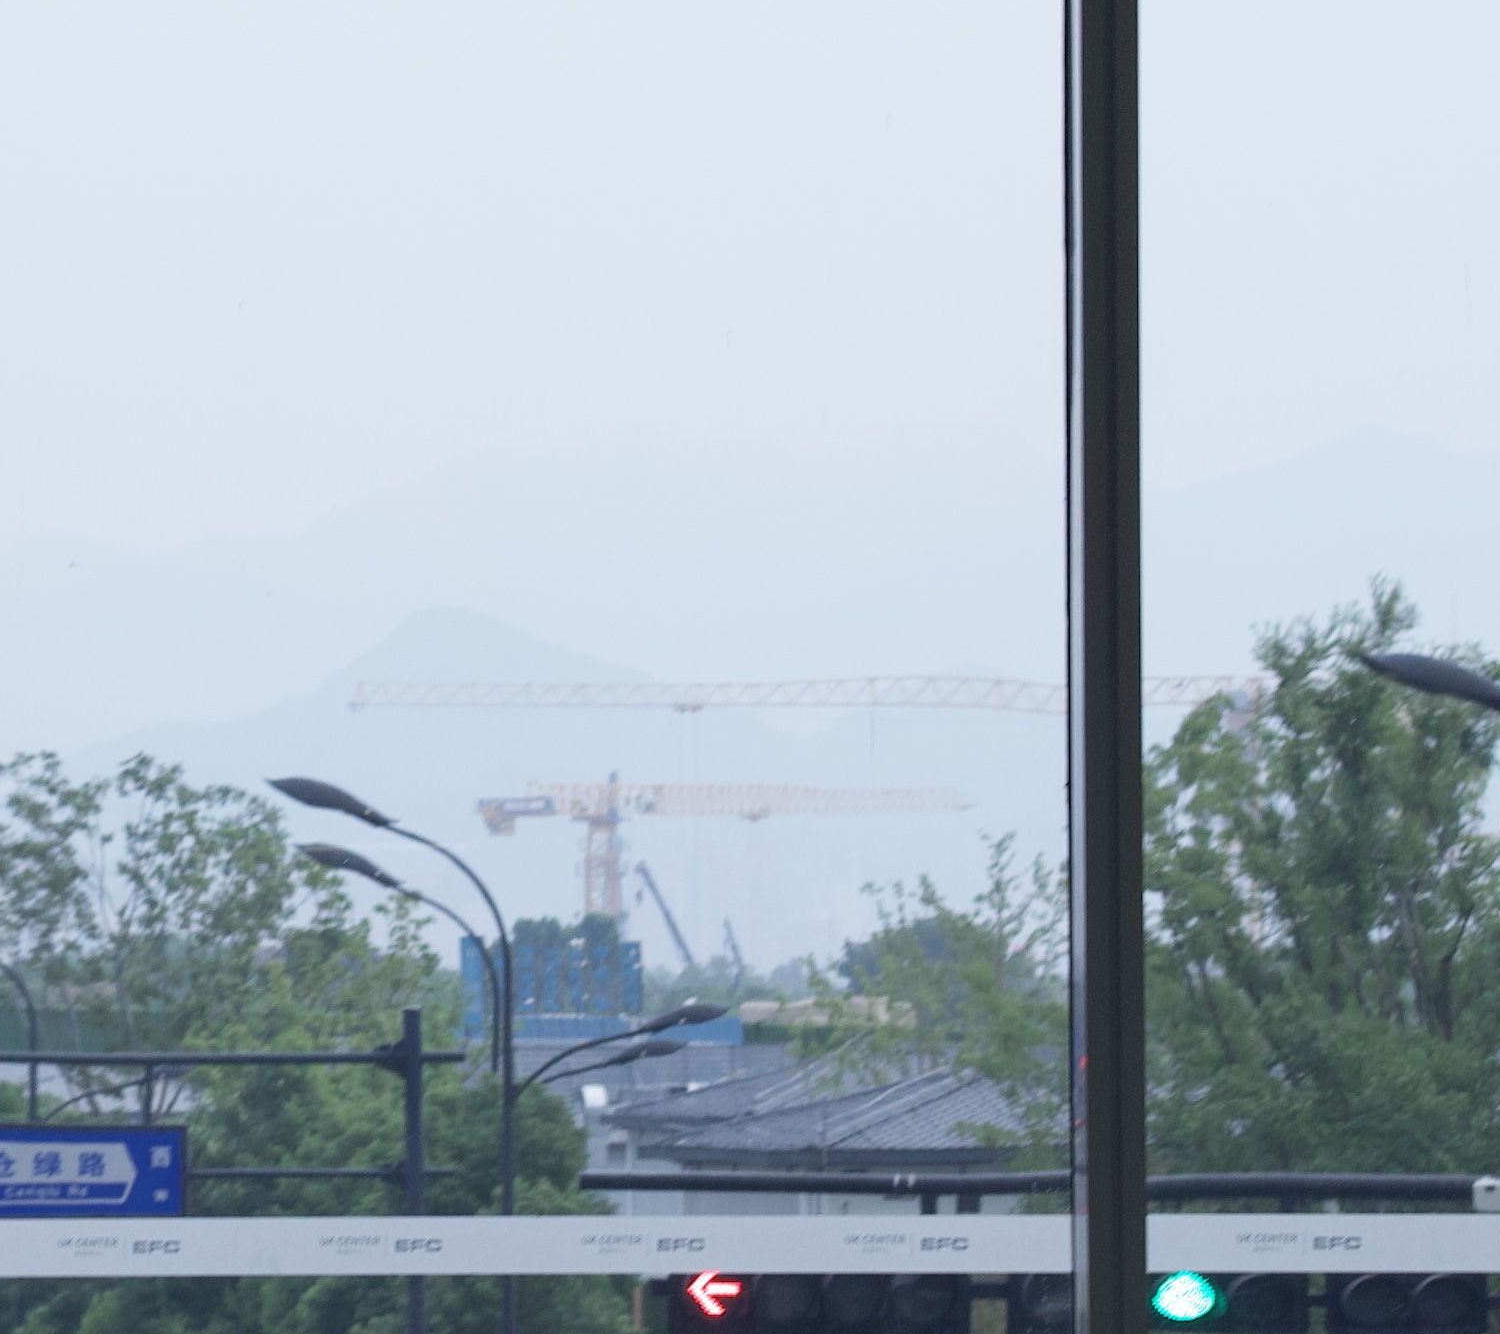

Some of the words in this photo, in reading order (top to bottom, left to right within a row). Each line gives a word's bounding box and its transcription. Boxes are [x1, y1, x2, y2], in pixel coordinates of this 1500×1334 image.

[132, 1239, 181, 1255] EFC
[394, 1238, 443, 1253] EFC
[656, 1237, 705, 1252] EFC
[920, 1237, 969, 1252] EFC
[1312, 1235, 1362, 1251] EFC
